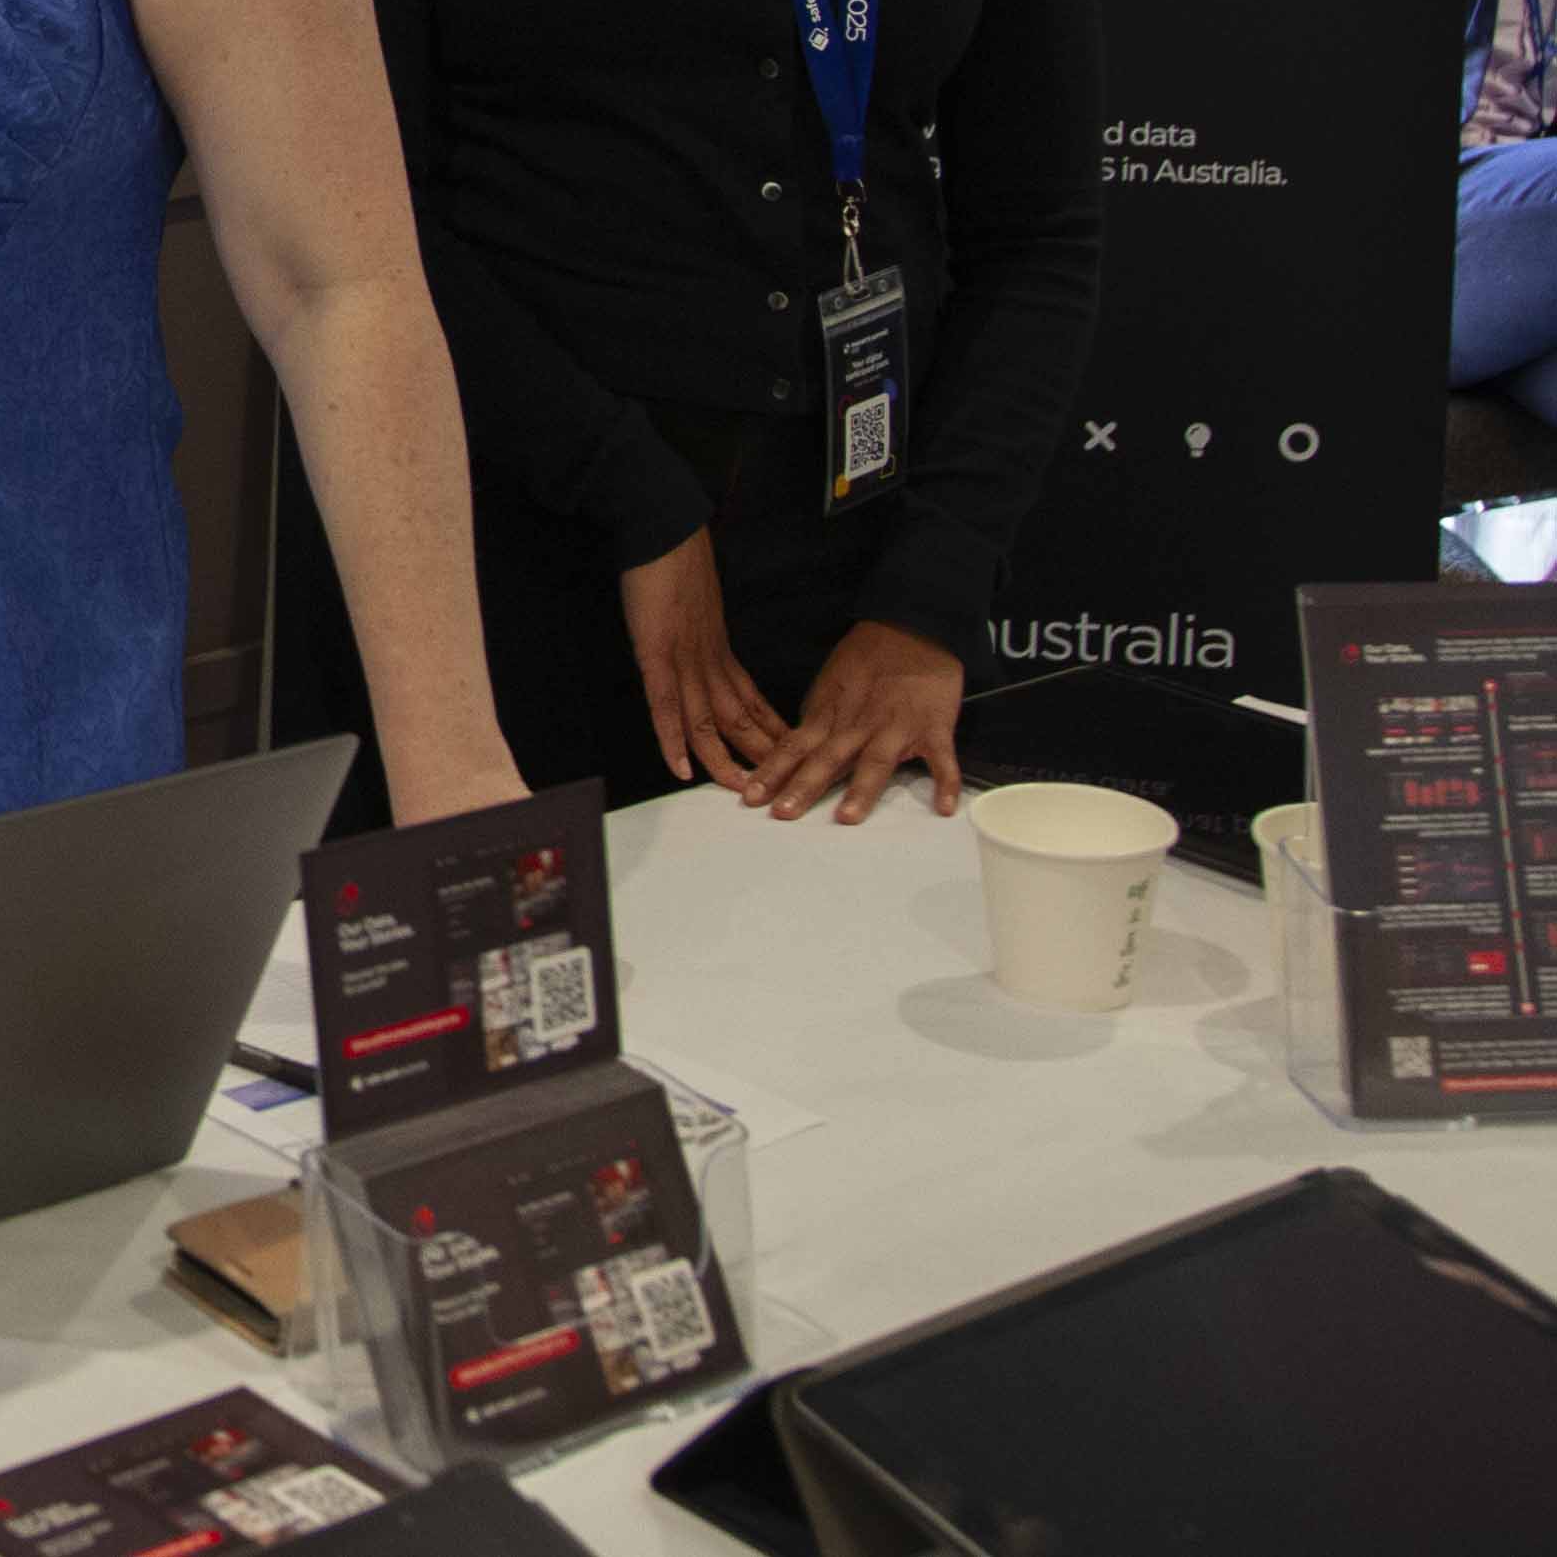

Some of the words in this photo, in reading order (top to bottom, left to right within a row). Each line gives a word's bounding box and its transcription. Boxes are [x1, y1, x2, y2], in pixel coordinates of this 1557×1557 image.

[1130, 121, 1196, 147] data
[1122, 156, 1148, 181] in
[1154, 159, 1287, 185] Australia.
[988, 611, 1236, 669] ustralia
